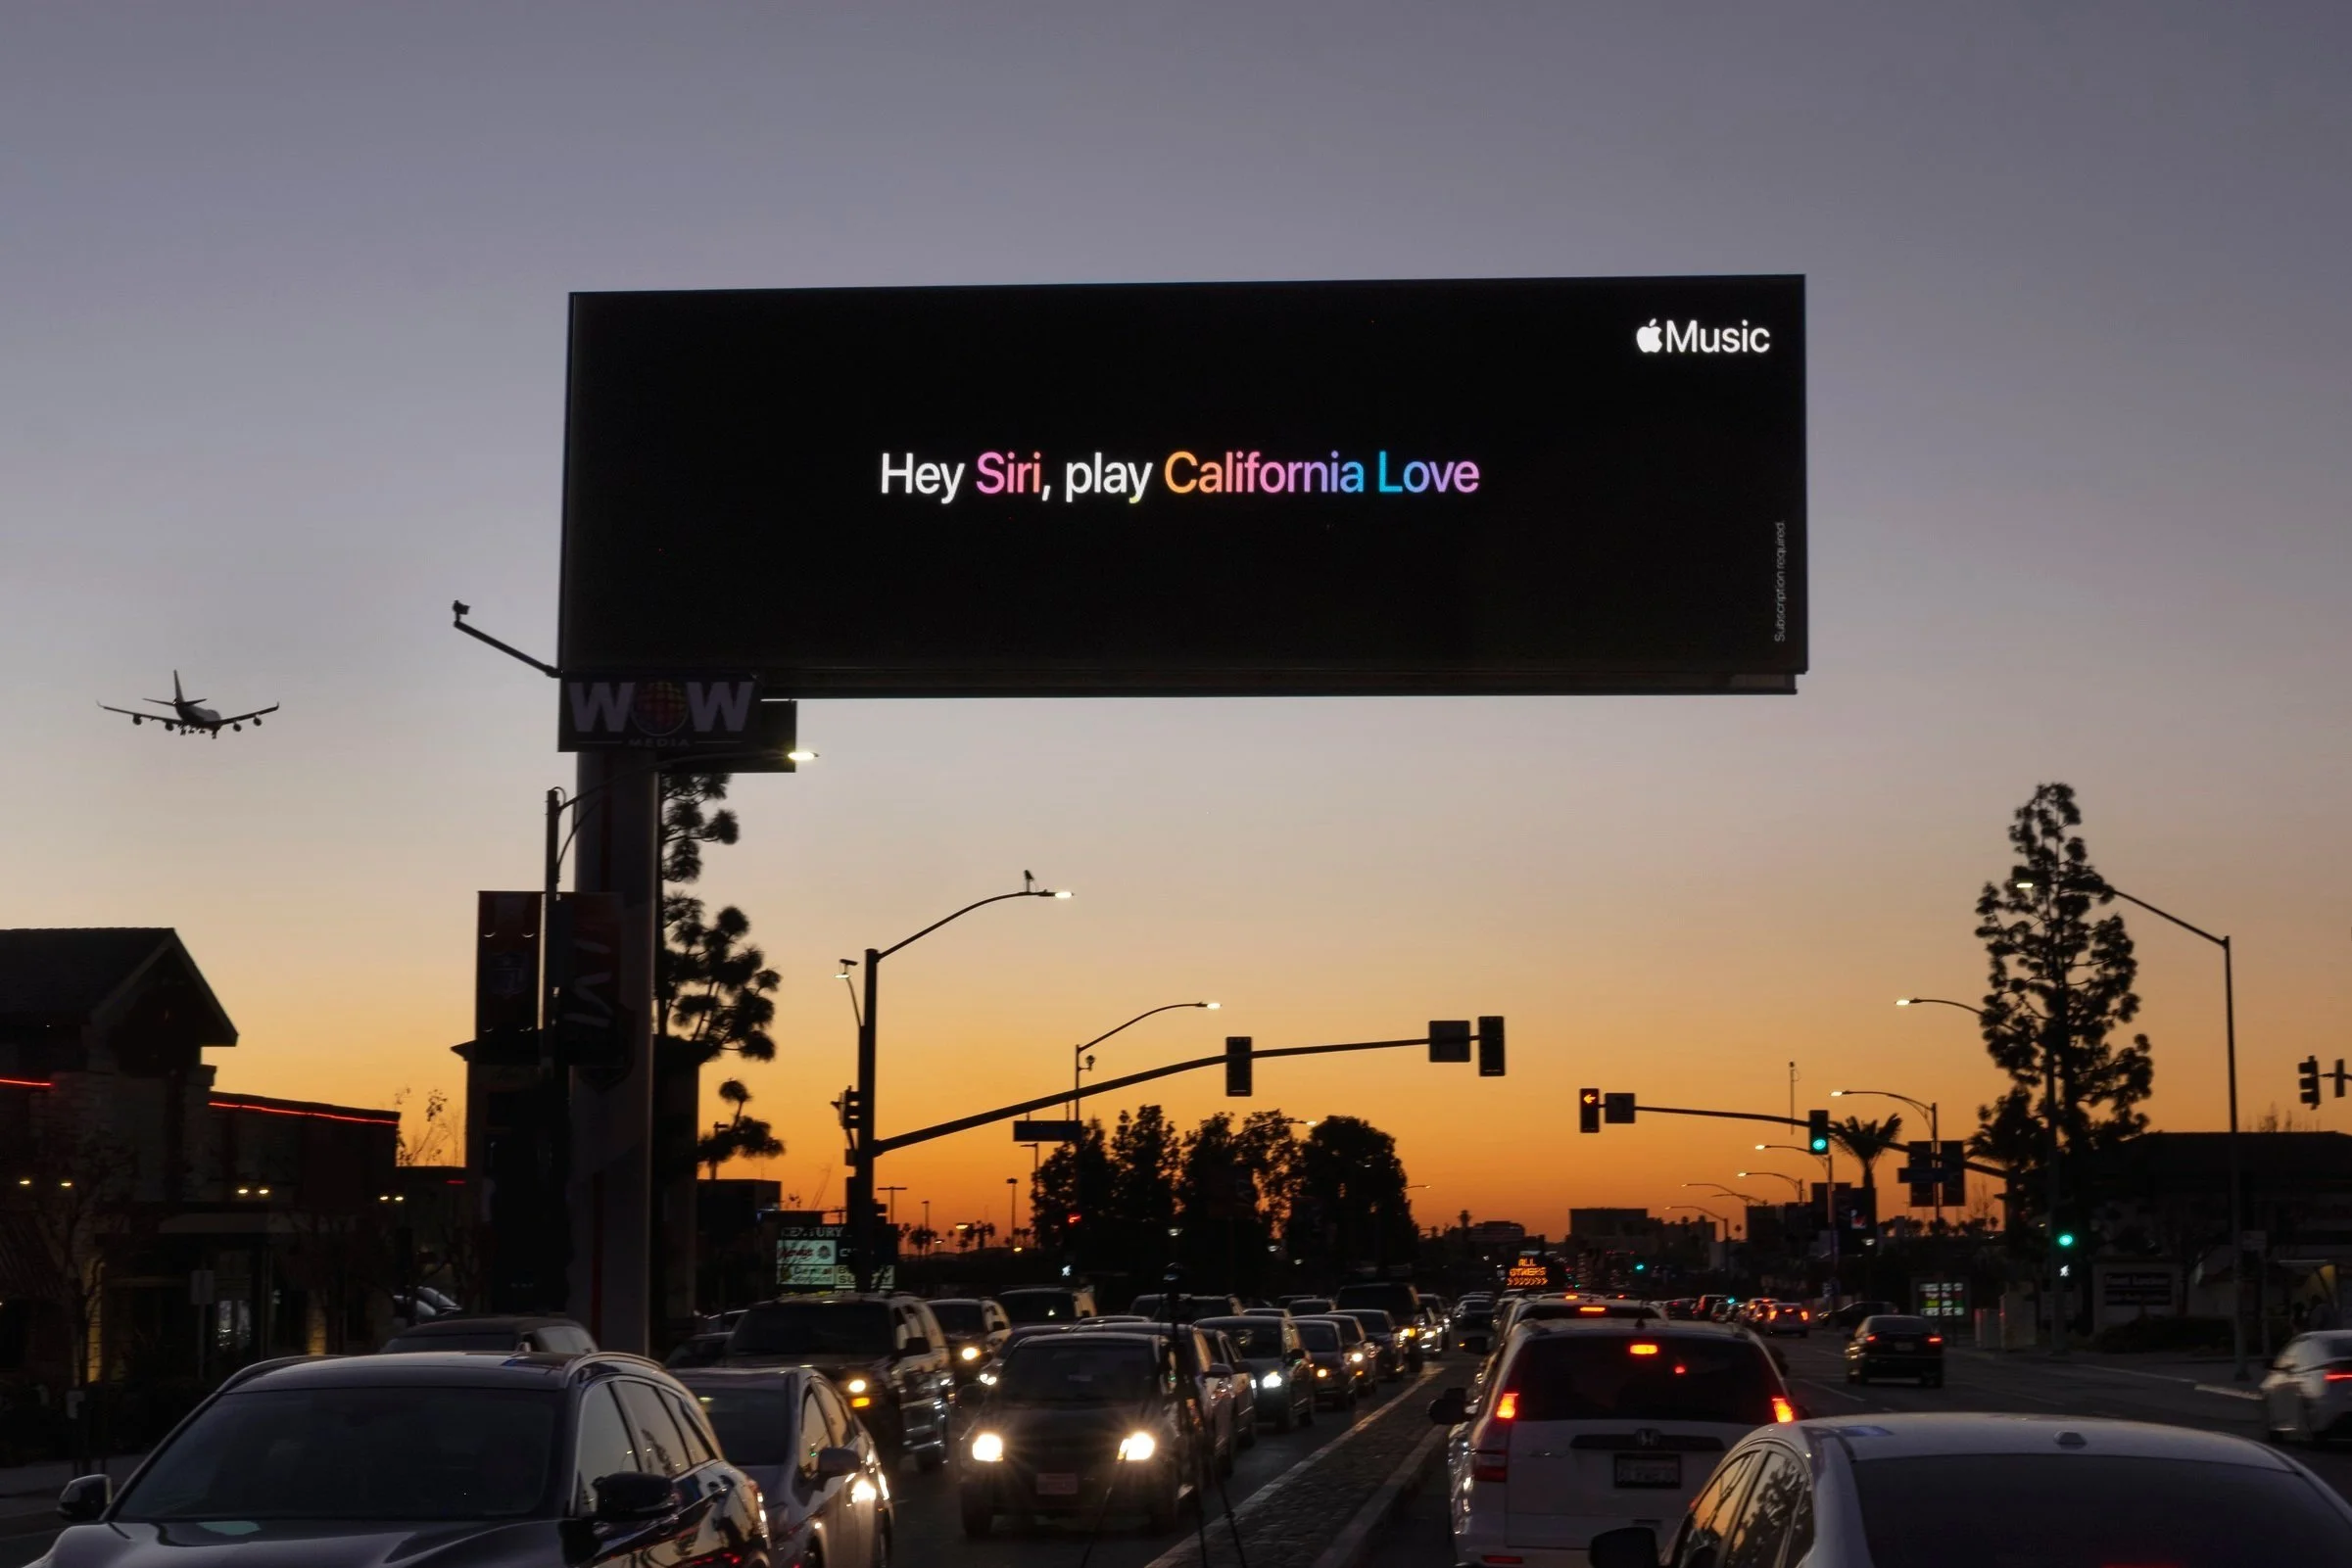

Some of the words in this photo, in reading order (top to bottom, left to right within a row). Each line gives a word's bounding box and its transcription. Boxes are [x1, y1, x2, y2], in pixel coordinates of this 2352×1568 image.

[1665, 318, 1771, 354] Music
[880, 451, 966, 504] Hey
[975, 450, 1052, 502] Siri,
[1064, 451, 1154, 505] play
[1163, 449, 1366, 496] California
[1377, 450, 1481, 495] Love
[1774, 520, 1787, 569] required.
[1774, 570, 1787, 642] Subscription
[568, 679, 755, 736] WOW
[628, 737, 692, 748] MEDIA
[1517, 1257, 1538, 1267] ALL
